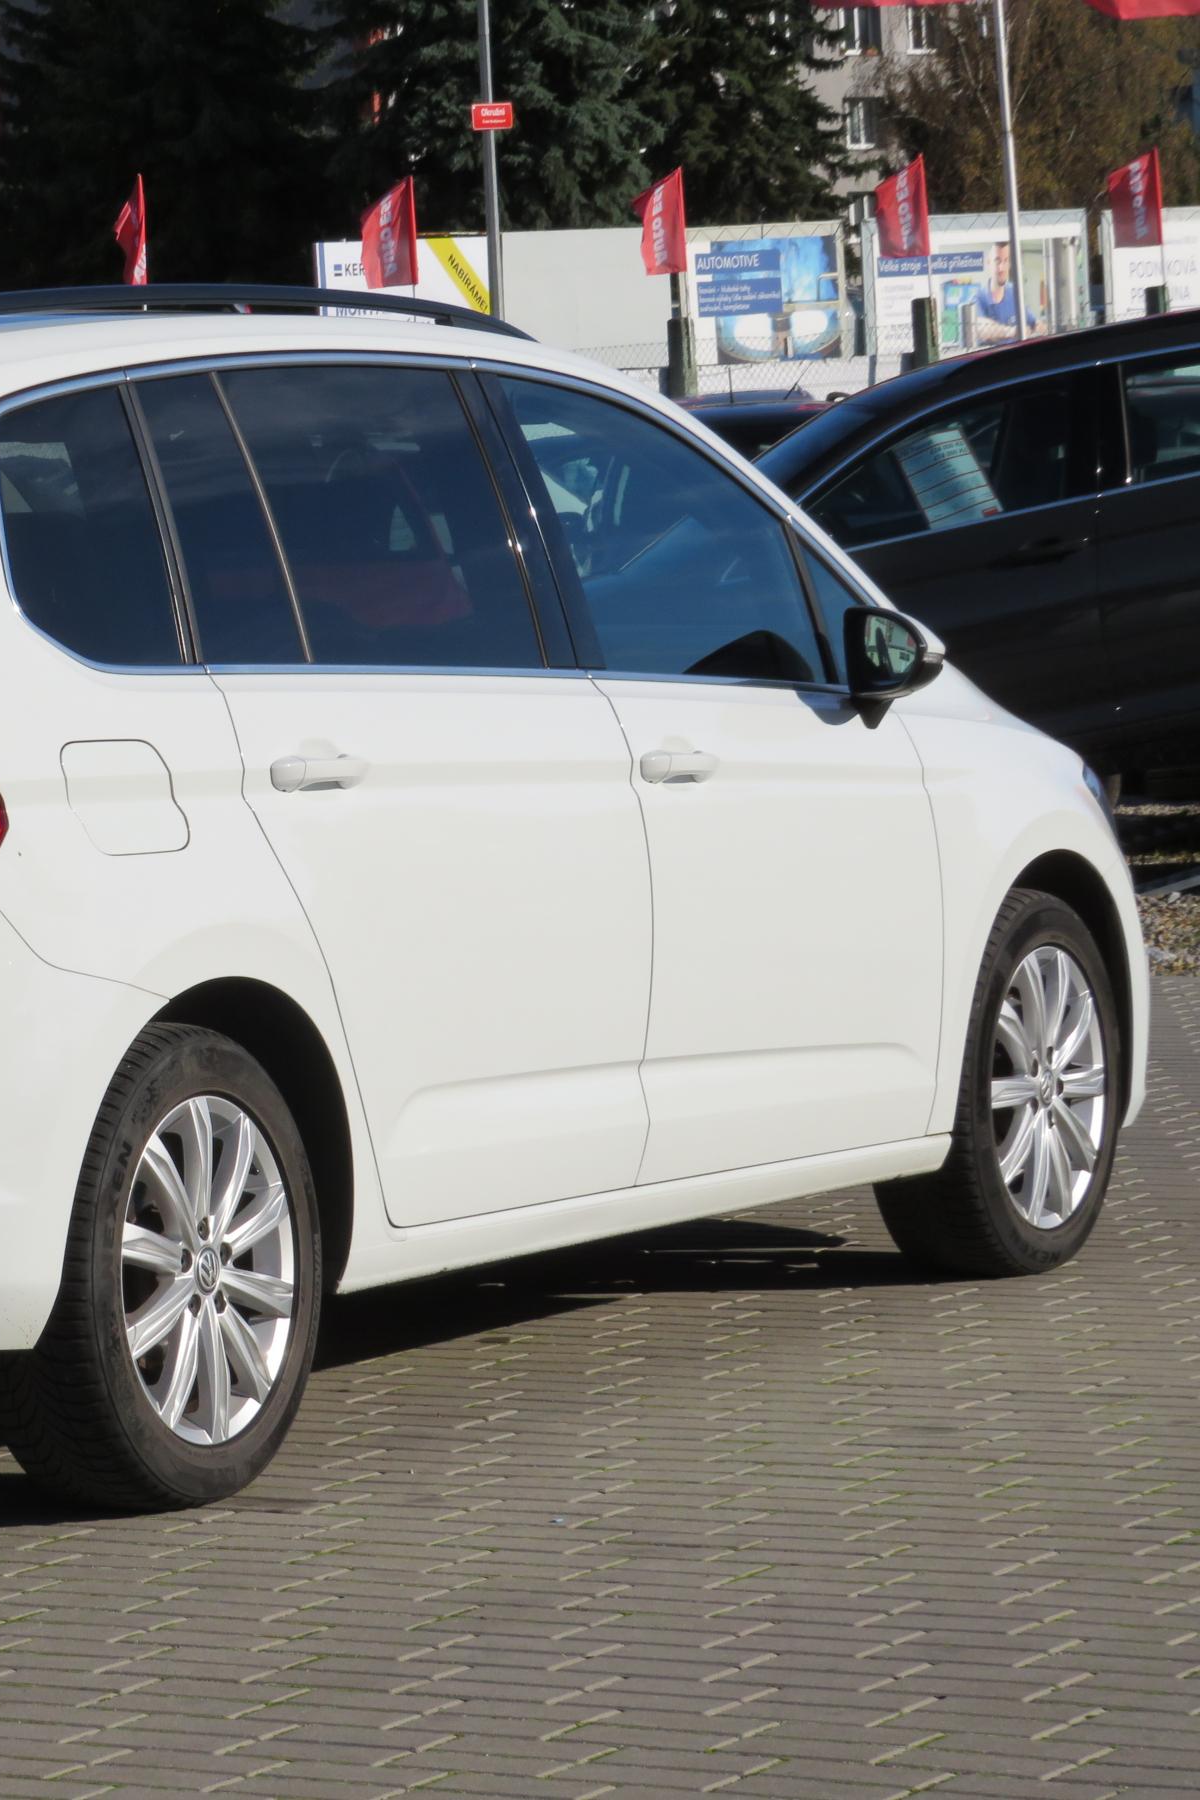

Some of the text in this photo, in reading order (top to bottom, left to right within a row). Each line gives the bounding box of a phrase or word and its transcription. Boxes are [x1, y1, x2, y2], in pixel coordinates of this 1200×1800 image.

[344, 263, 365, 277] KER
[697, 253, 760, 270] AUTOMOTIVE
[448, 253, 489, 312] NABÍRÁME!
